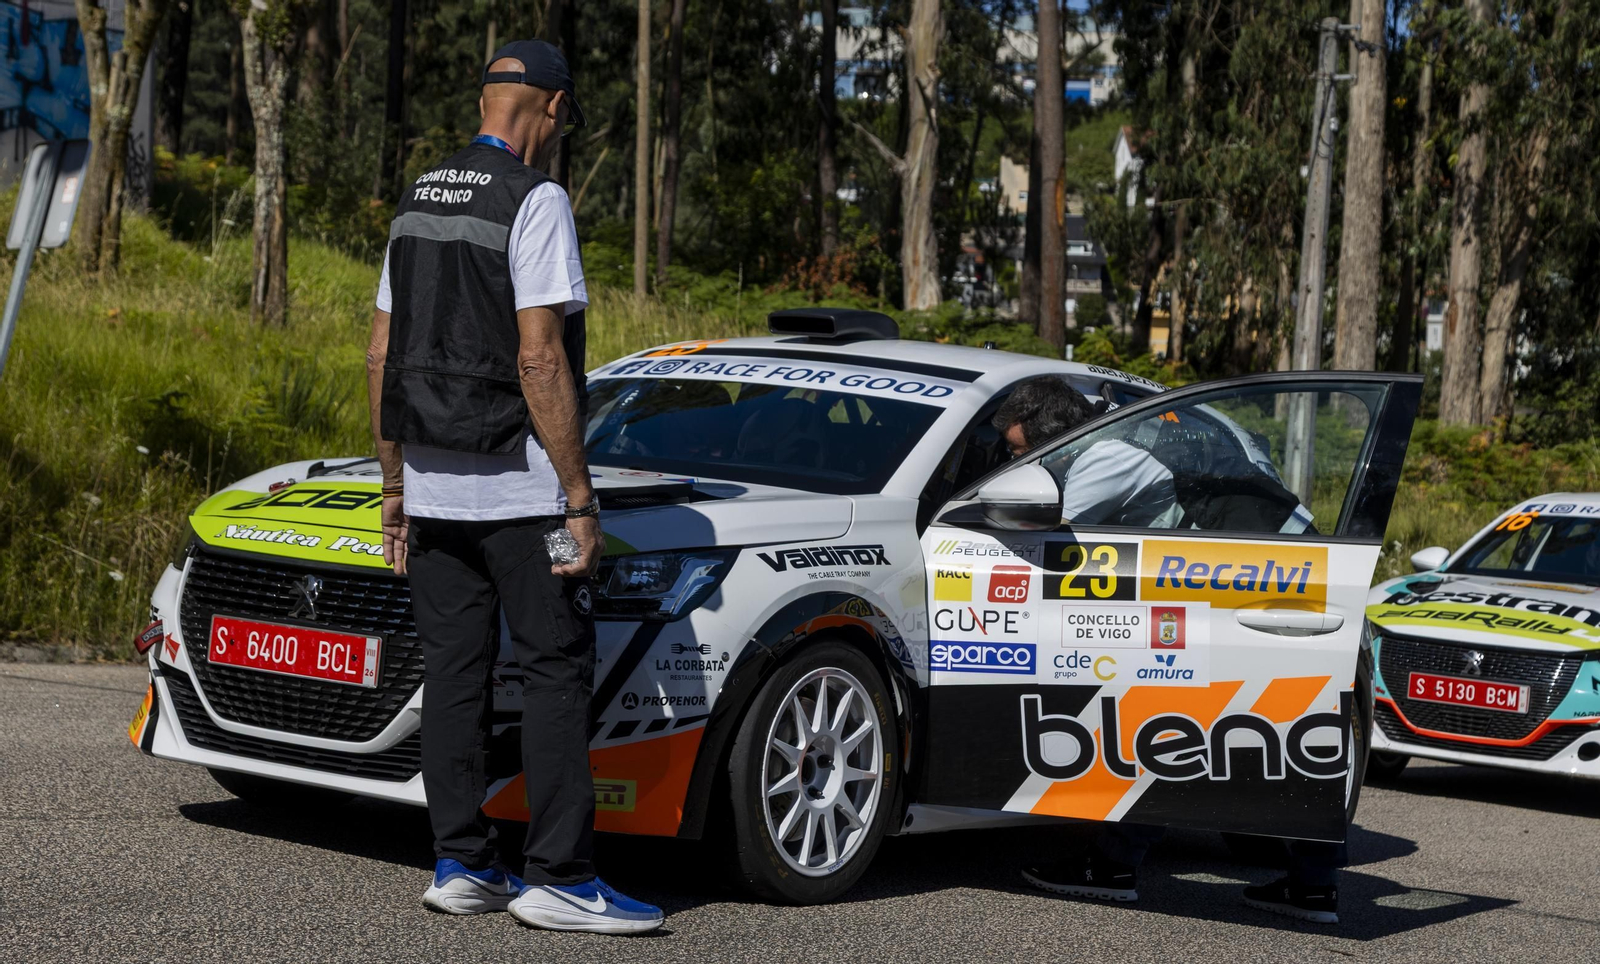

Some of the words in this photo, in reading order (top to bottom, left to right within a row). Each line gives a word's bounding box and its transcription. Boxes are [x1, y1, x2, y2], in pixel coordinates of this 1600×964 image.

[416, 169, 492, 185] COMISARIO
[414, 184, 473, 203] TÉCNICO
[683, 361, 767, 377] RACE
[764, 366, 836, 384] FOR
[839, 374, 954, 398] GOOD
[1495, 511, 1540, 532] 16
[214, 524, 322, 548] Náutica
[756, 544, 892, 573] Valdinox
[952, 548, 1036, 558] PEUGEOT
[1059, 545, 1119, 598] 23
[1155, 555, 1313, 594] Recalvi
[994, 585, 1026, 601] acp
[1381, 591, 1600, 628] bestran
[1068, 614, 1140, 626] CONCELLO
[1076, 628, 1094, 639] DE
[1098, 628, 1132, 640] VIGO
[216, 626, 228, 655] S
[247, 631, 298, 665] 6400
[317, 640, 357, 675] BCL
[931, 644, 1031, 671] sparco
[364, 668, 374, 677] 26
[656, 659, 671, 671] LA
[675, 660, 725, 671] CORBATA
[1054, 671, 1078, 679] grupo
[1137, 668, 1194, 680] amura
[642, 696, 706, 707] PROPENOR
[1416, 678, 1425, 695] S
[1435, 680, 1476, 701] 5130
[1486, 687, 1517, 708] BCM
[1020, 690, 1354, 782] blend
